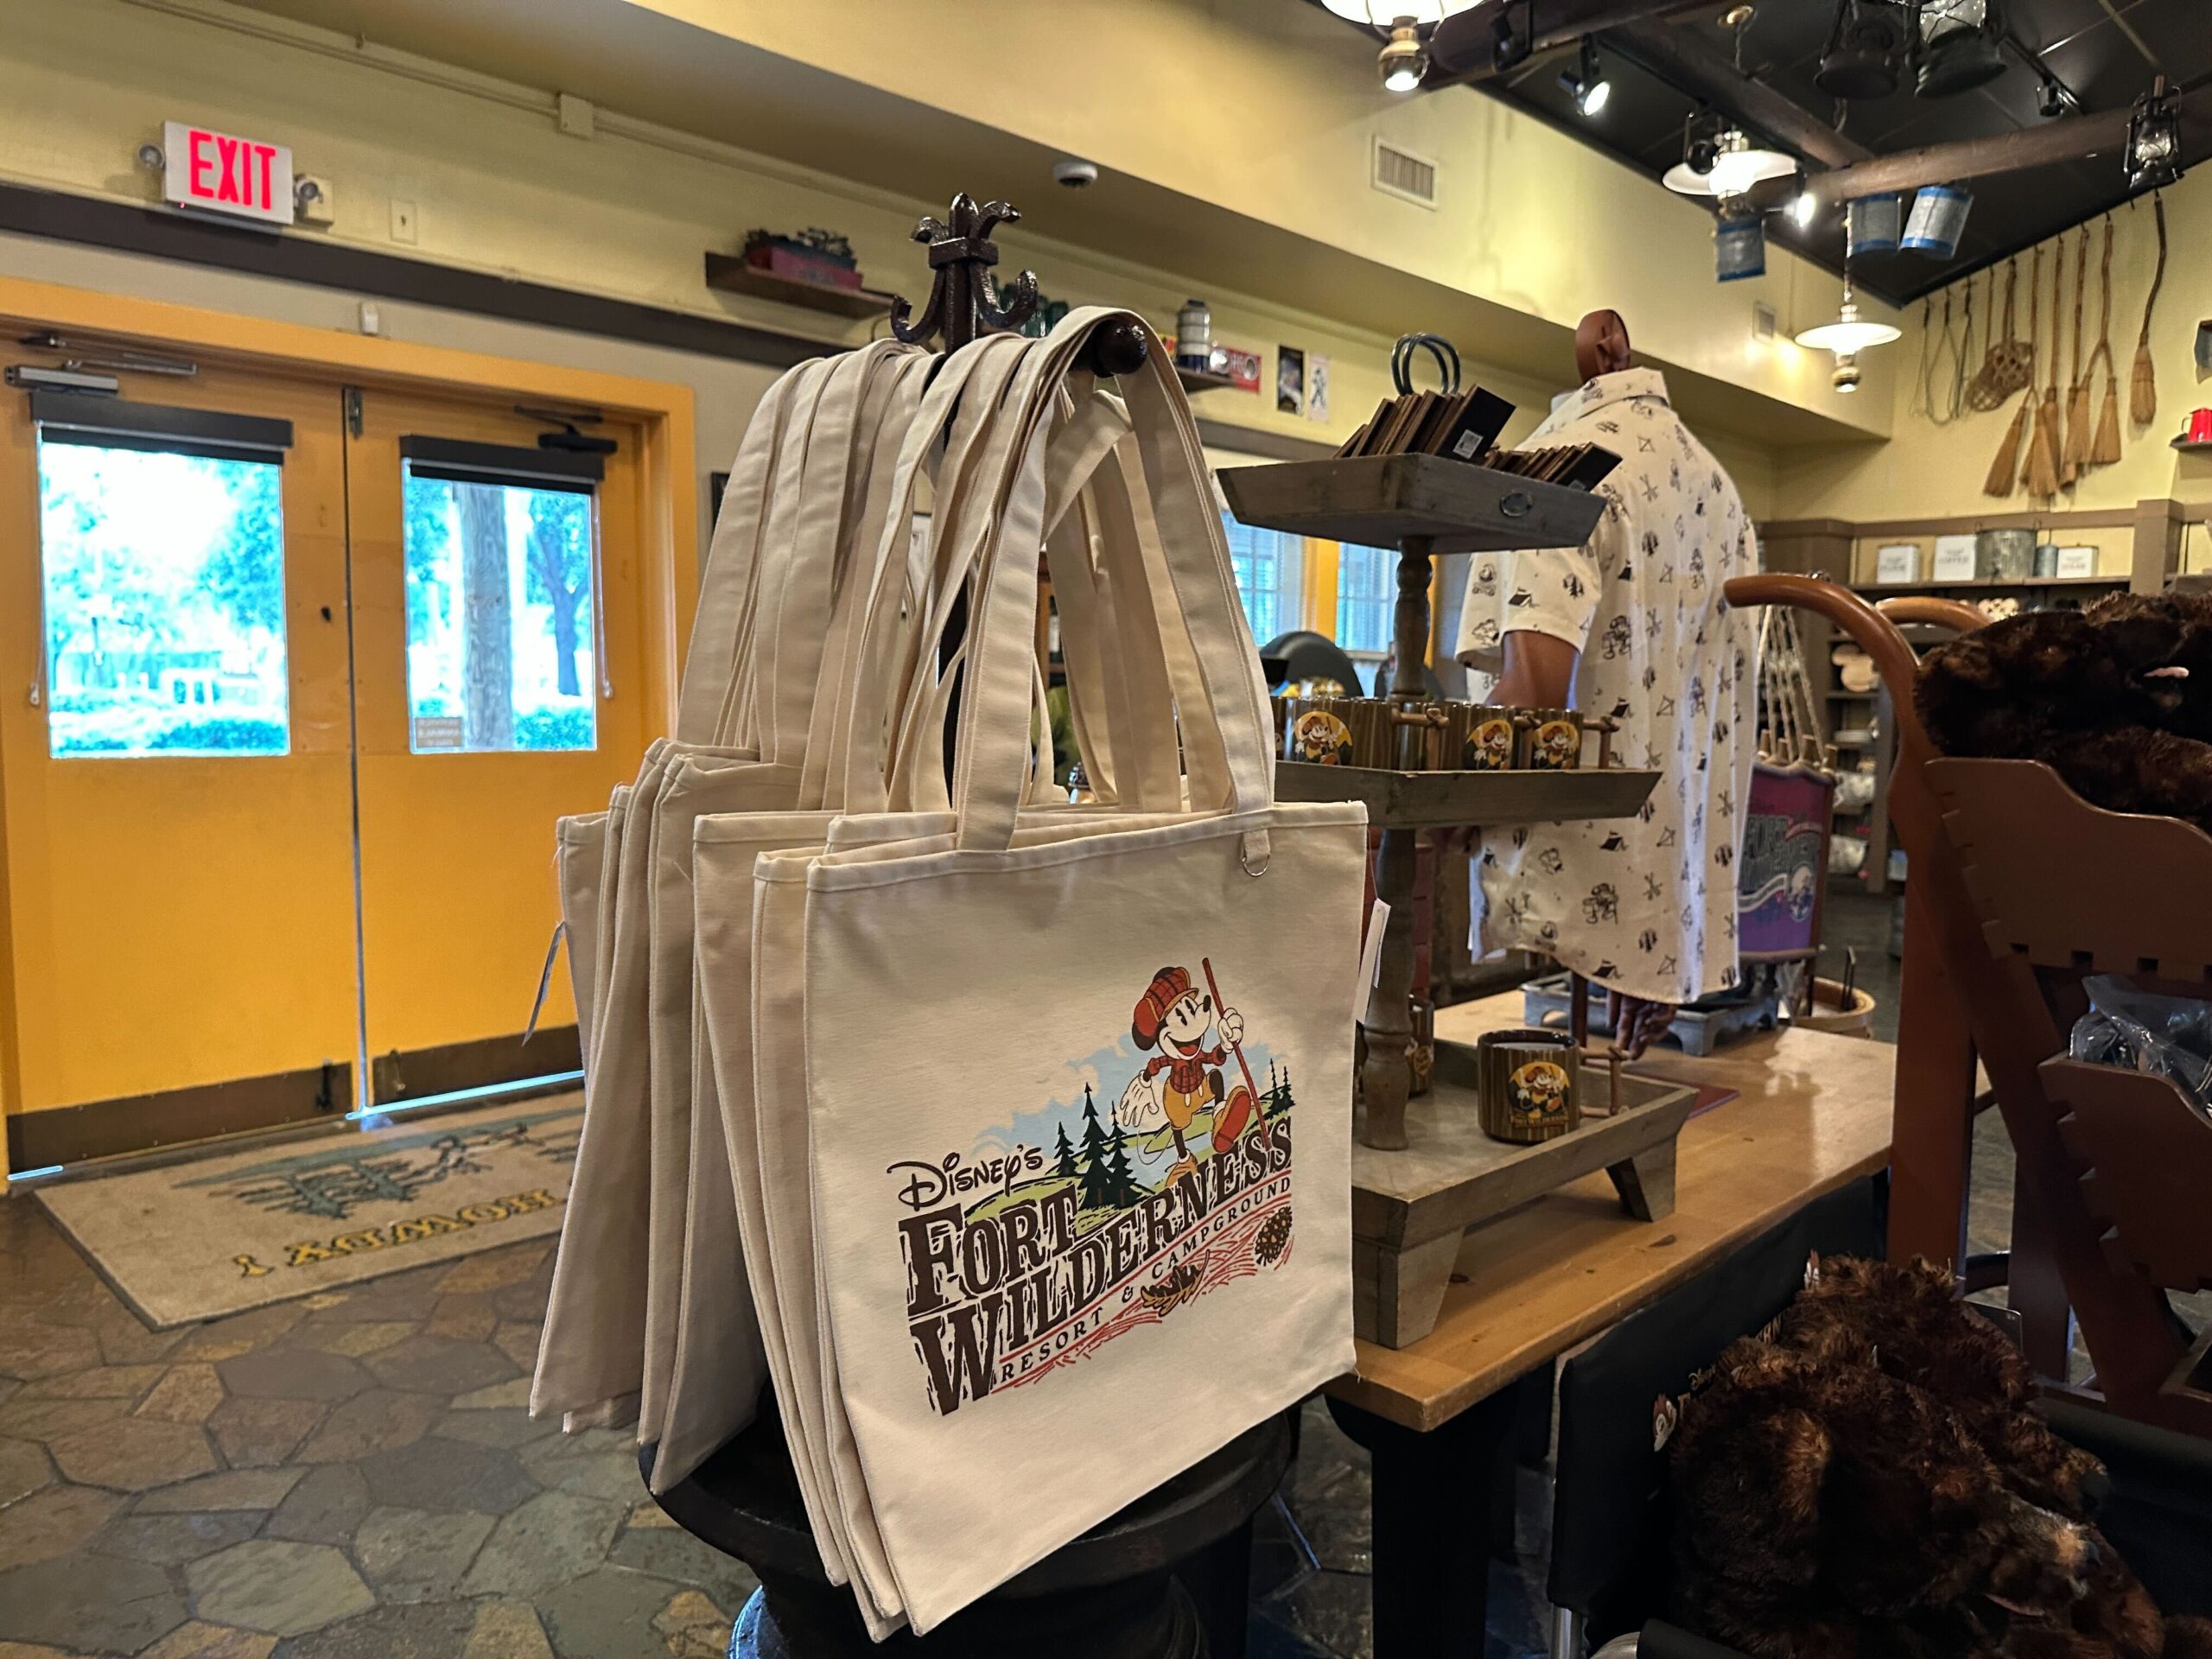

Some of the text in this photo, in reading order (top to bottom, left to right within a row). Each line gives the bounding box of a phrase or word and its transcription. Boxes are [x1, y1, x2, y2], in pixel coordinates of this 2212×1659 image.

[188, 129, 276, 212] EXIT
[898, 1185, 1078, 1317] FORT
[909, 1116, 1292, 1417] WILDERNESS
[1000, 1175, 1291, 1383] RESORT & CAMPGROUND
